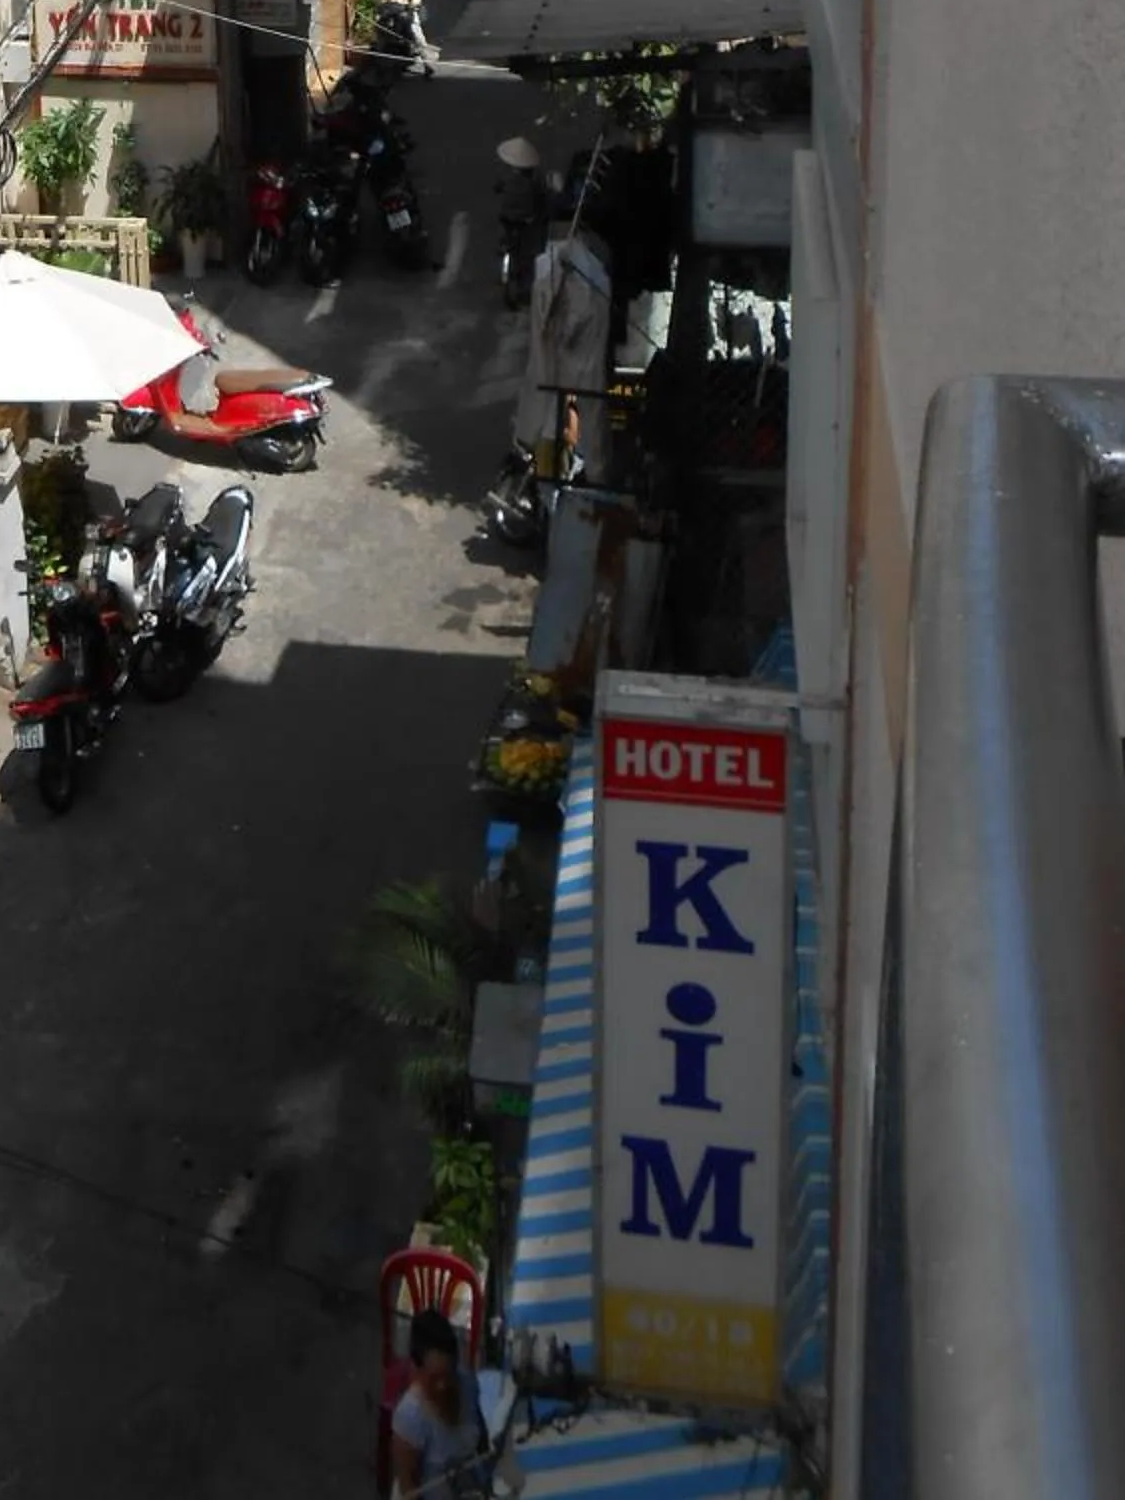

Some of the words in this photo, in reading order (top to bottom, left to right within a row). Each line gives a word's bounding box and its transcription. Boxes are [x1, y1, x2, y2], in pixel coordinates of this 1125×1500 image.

[106, 11, 182, 42] TRANG
[190, 13, 204, 39] 2
[615, 737, 774, 788] HOTEL
